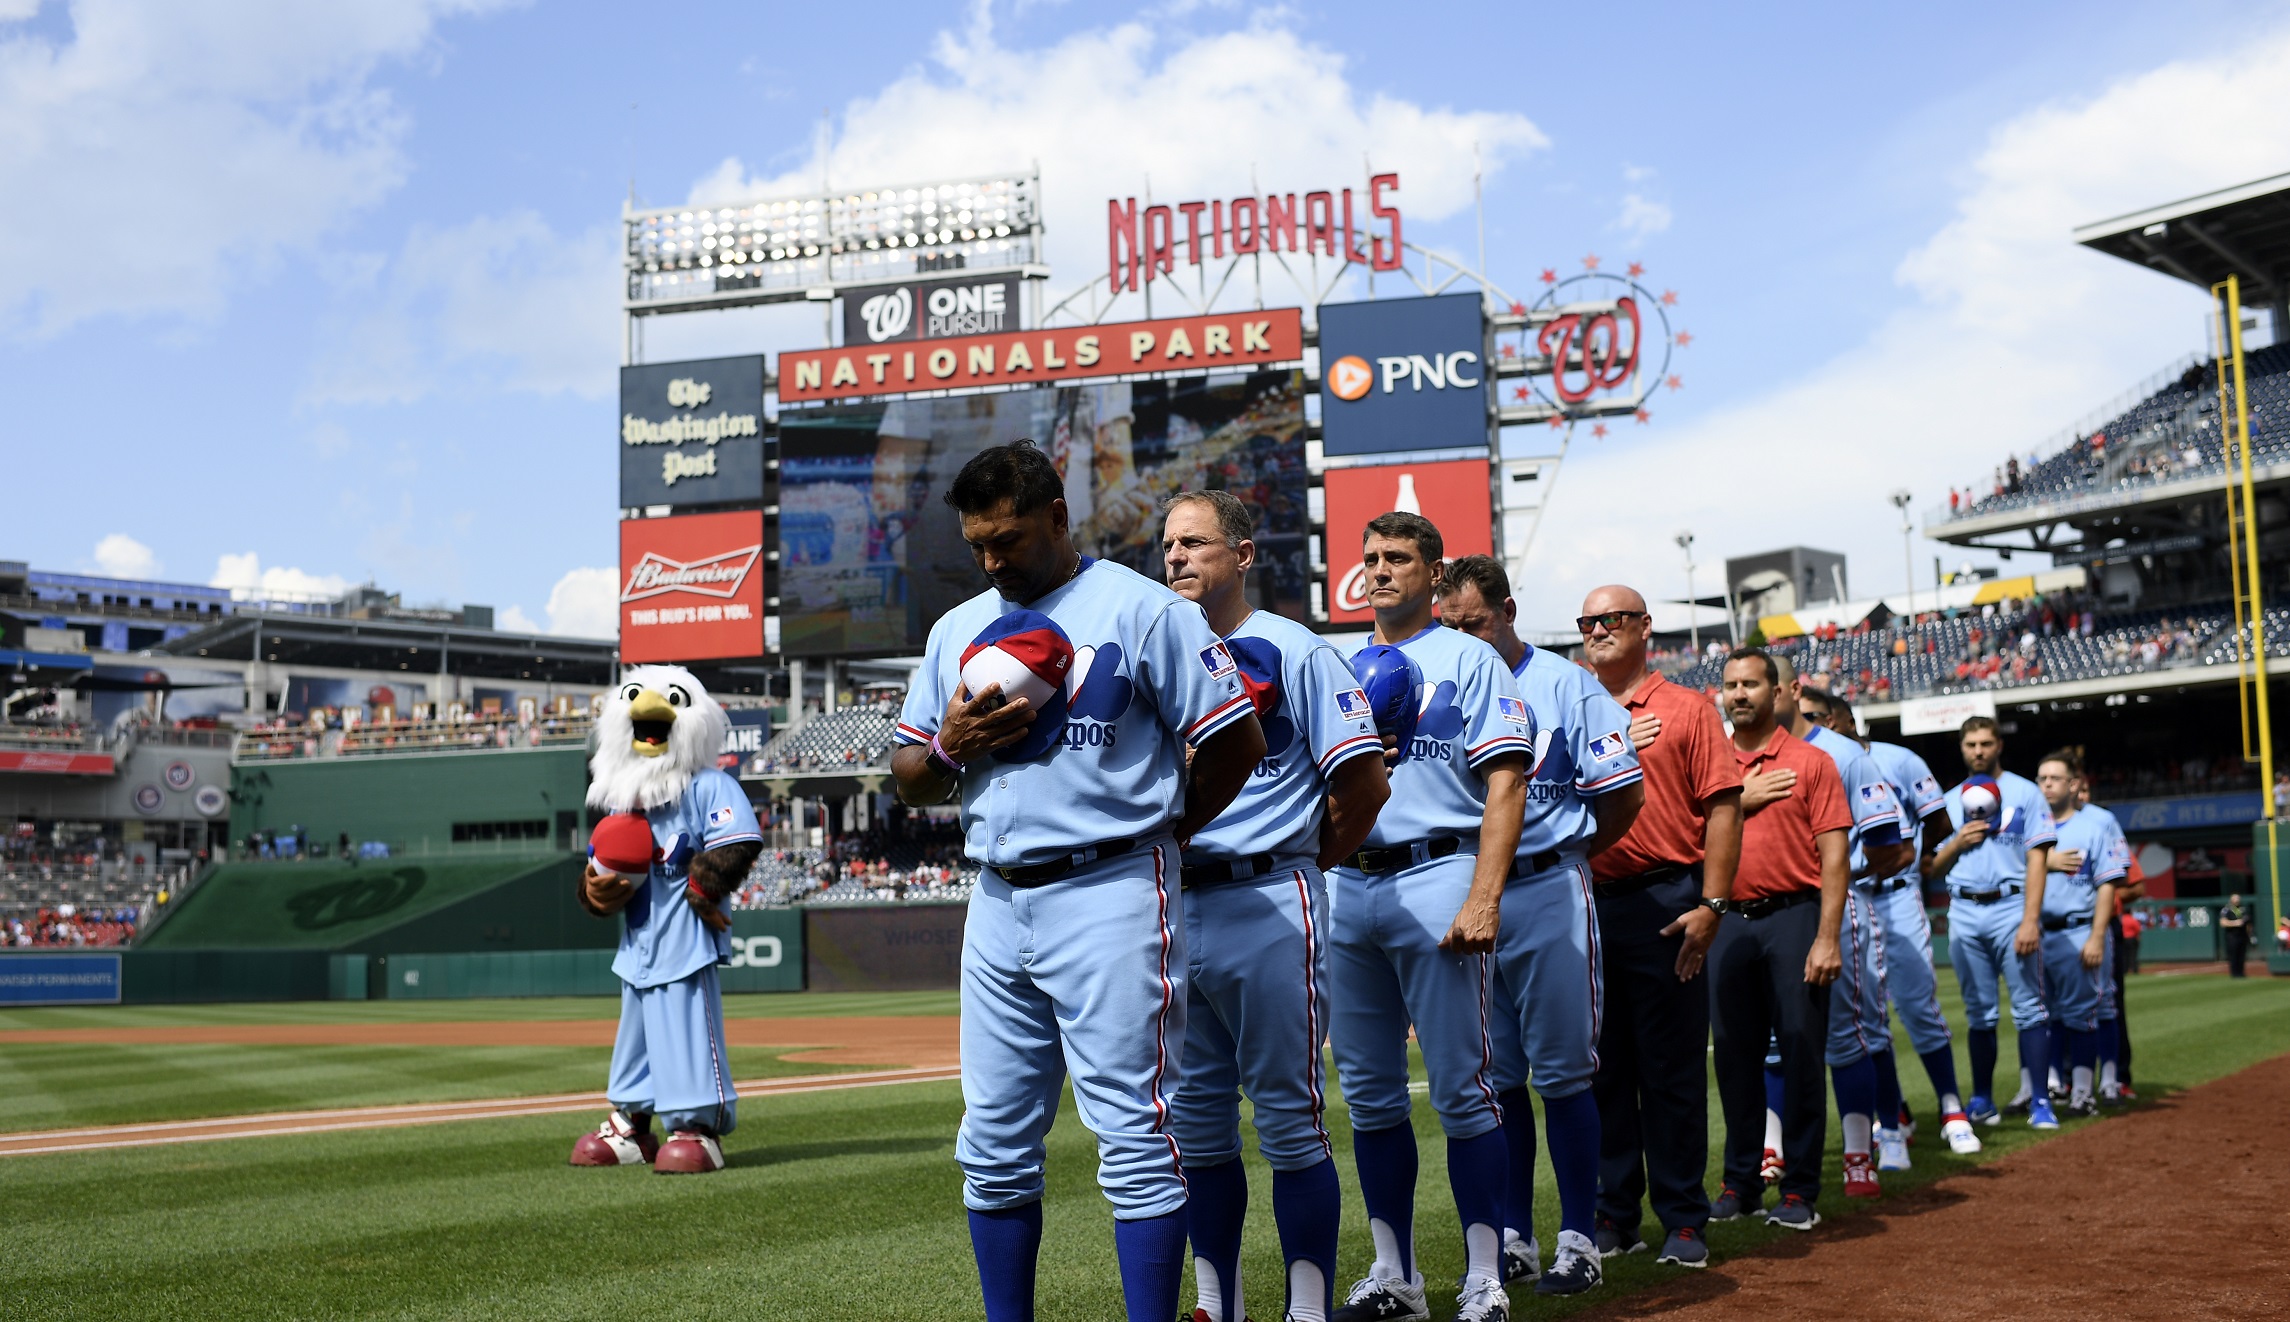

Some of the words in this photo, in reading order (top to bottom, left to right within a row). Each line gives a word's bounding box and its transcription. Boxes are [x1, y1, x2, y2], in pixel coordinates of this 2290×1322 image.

[1110, 173, 1401, 292] NATIONALS
[928, 283, 1006, 317] ONE
[928, 311, 1006, 337] PURSUIT
[796, 334, 1100, 389] NATIONALS
[1130, 321, 1271, 361] PARK
[1377, 350, 1479, 394] PNC
[667, 378, 711, 409] The
[622, 412, 758, 446] Washington
[662, 449, 717, 486] Post
[632, 561, 746, 589] Budweiser
[630, 609, 658, 626] THIS
[659, 607, 696, 624] BUD'S
[697, 605, 722, 622] FOR
[724, 728, 762, 753] AME
[1055, 722, 1116, 750] xpos
[1526, 784, 1568, 803] xpos
[884, 928, 958, 945] WHOSE
